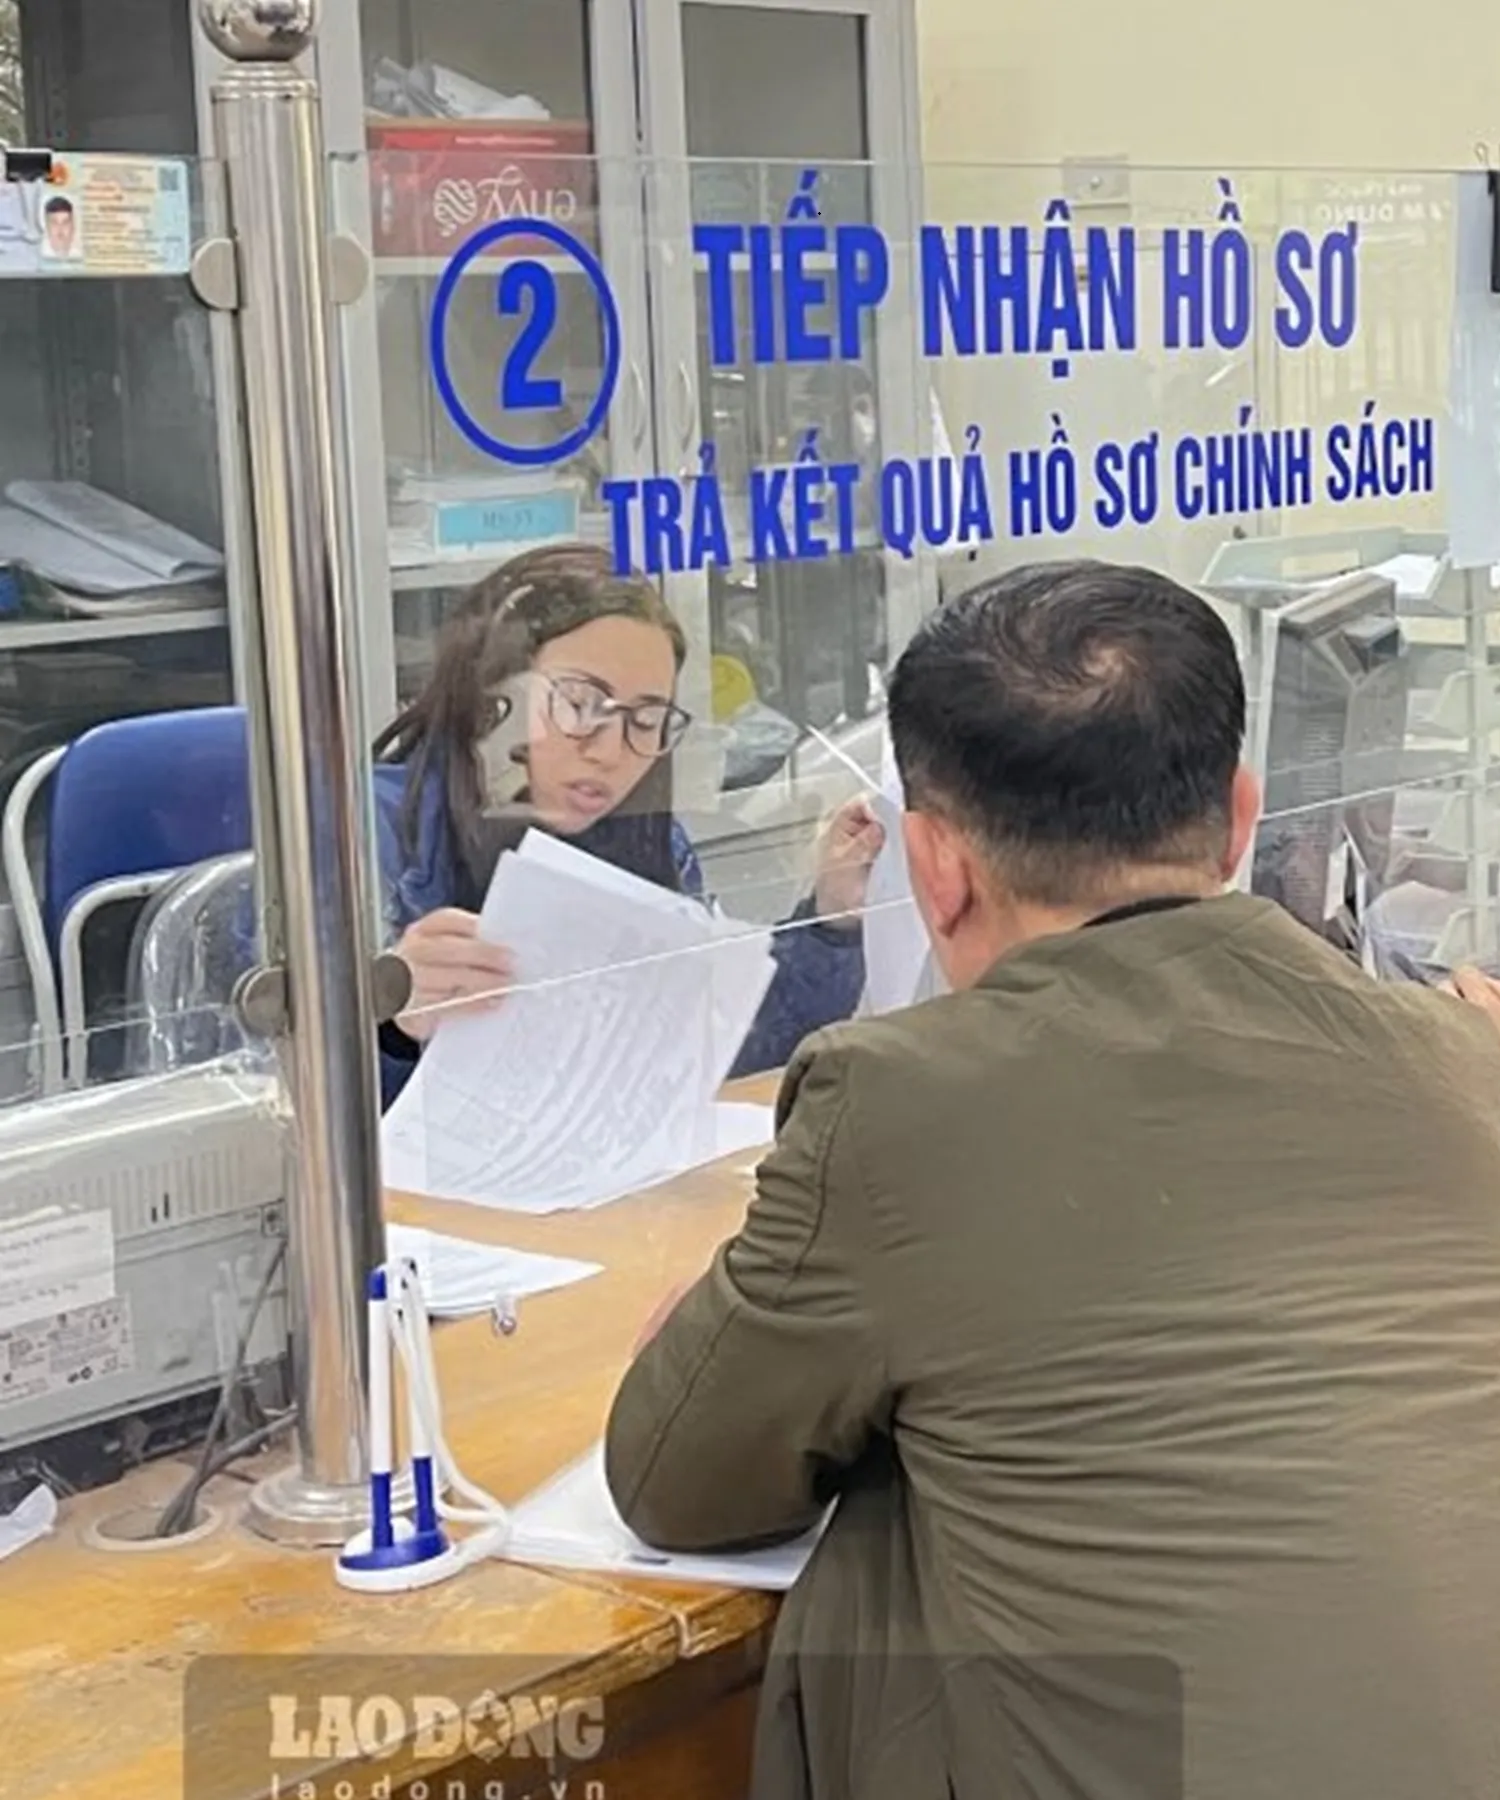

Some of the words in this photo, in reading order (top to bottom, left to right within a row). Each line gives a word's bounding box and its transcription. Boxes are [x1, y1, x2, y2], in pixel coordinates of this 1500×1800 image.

[496, 260, 564, 412] 2
[692, 169, 890, 367] TIẾP
[920, 198, 1136, 379] NHẬN
[1163, 177, 1251, 351] HỒ
[1274, 222, 1358, 350] SƠ
[601, 442, 731, 578] TRẢ
[748, 427, 863, 564] KẾT
[879, 424, 994, 558] QUẢ
[1009, 412, 1078, 538] HỒ
[1094, 432, 1160, 530] SƠ
[1174, 405, 1312, 519] CHÍNH
[1326, 400, 1434, 502] SÁCH
